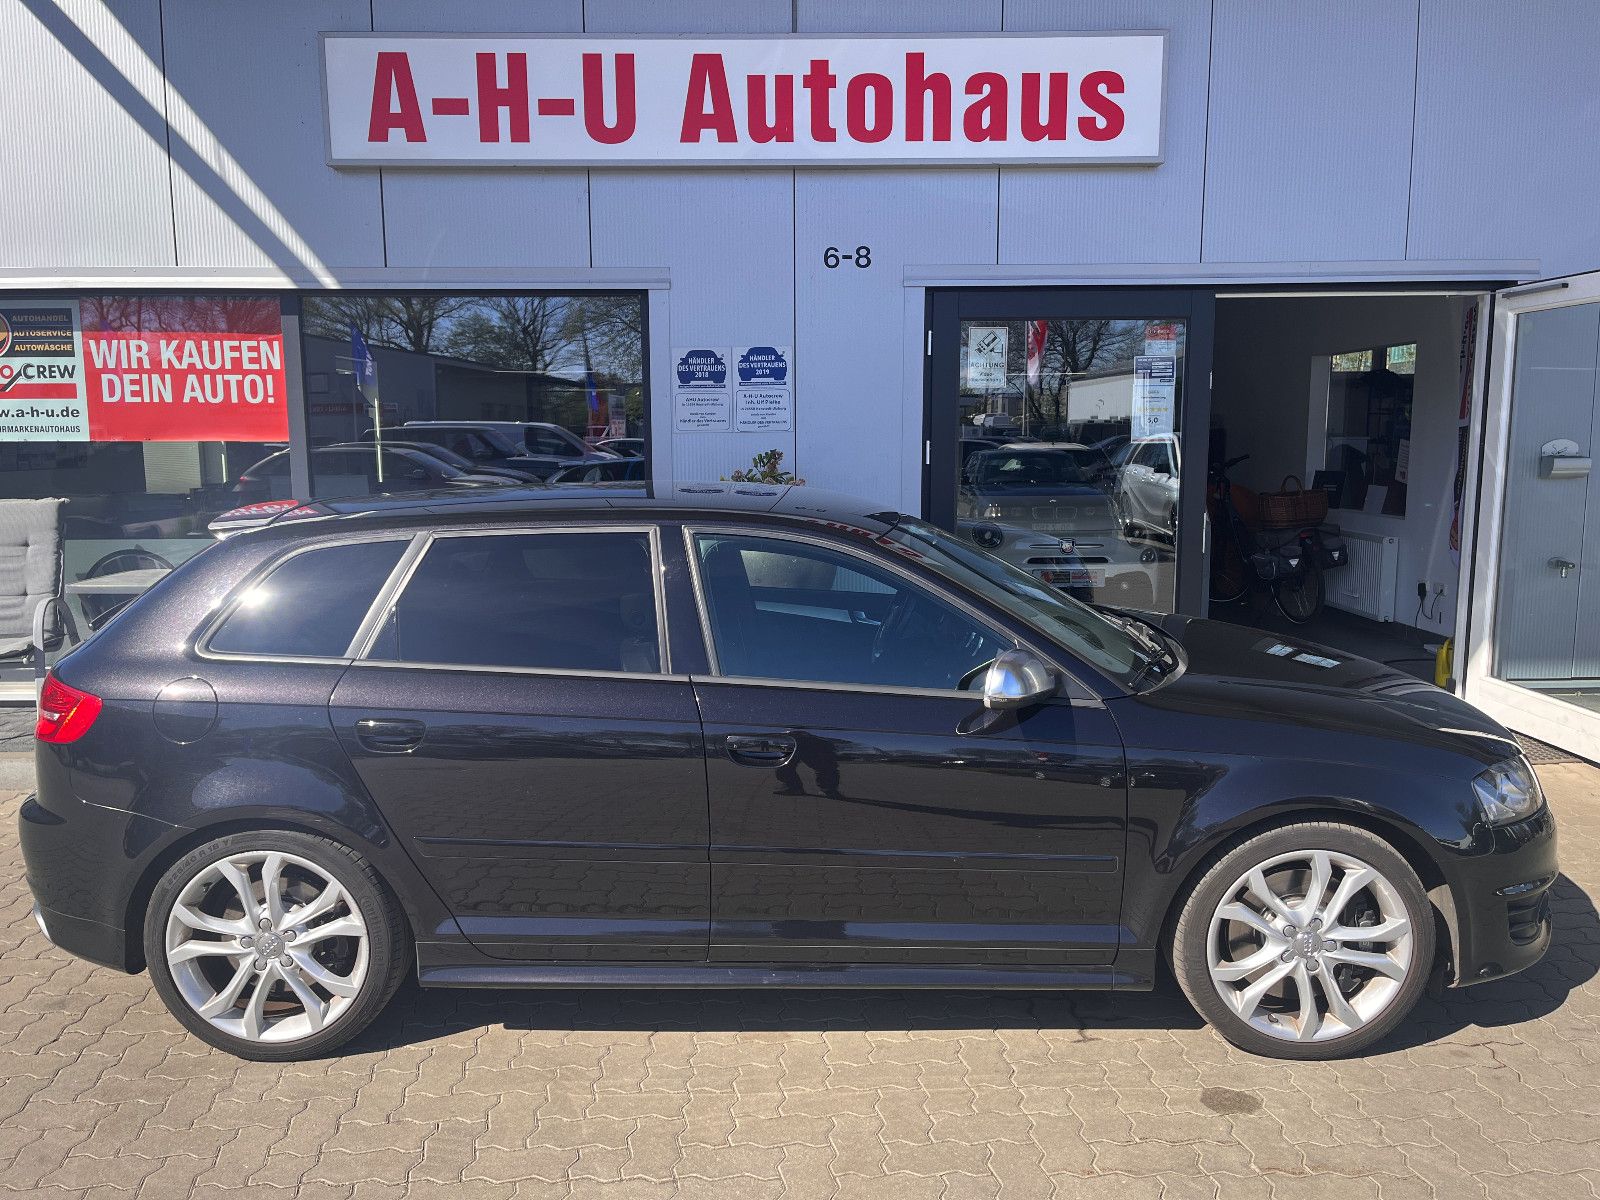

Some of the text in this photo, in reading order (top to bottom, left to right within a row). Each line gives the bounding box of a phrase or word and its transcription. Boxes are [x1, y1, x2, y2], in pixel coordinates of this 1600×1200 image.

[368, 52, 1126, 144] A-H-U Autohaus
[823, 246, 873, 270] 6-8
[11, 314, 69, 322] AUTOHANDEL
[13, 329, 72, 337] AUTOSERVICE
[14, 342, 73, 352] AUTOWÄSCHE
[89, 340, 281, 371] WIR KAUFEN
[688, 356, 715, 364] HÄNDLER
[101, 374, 275, 404] DEIN AUTO!
